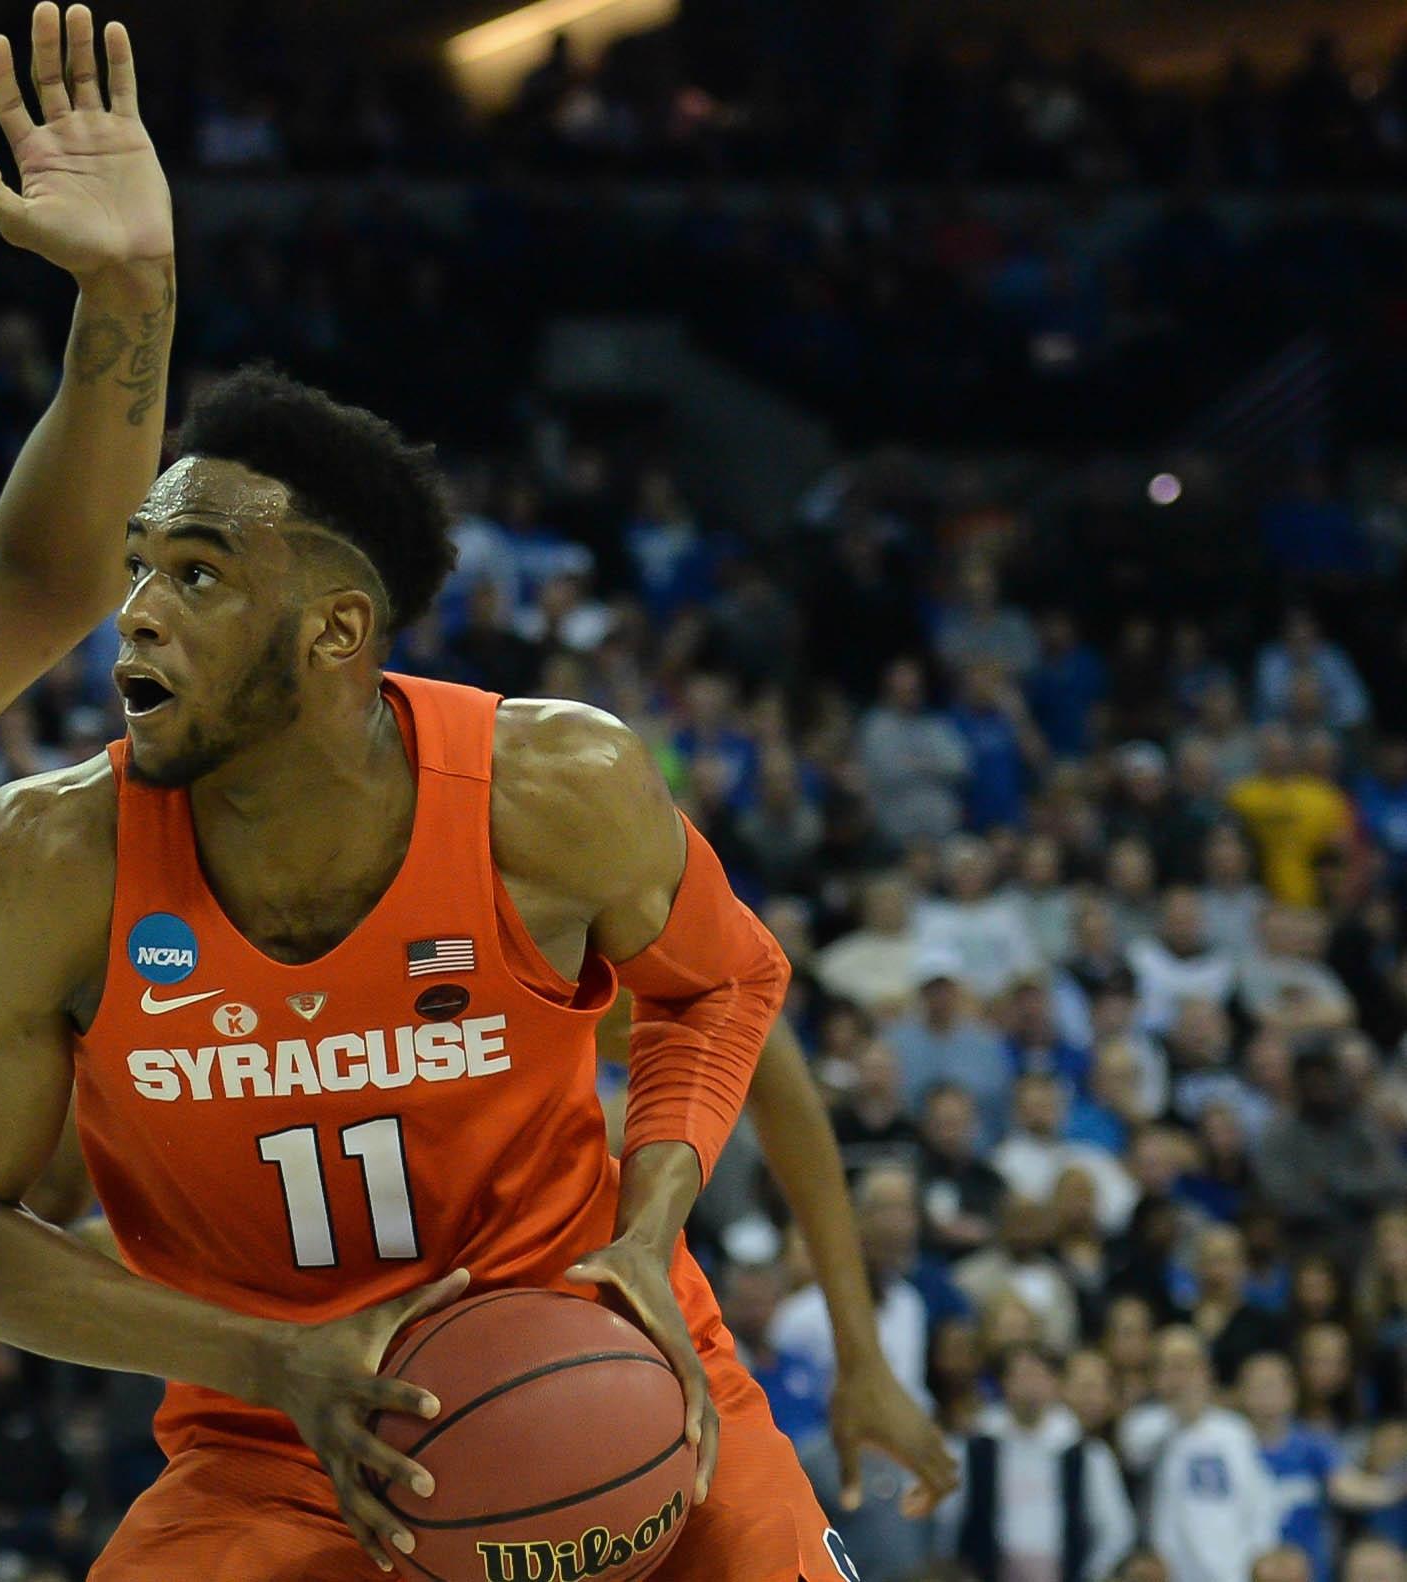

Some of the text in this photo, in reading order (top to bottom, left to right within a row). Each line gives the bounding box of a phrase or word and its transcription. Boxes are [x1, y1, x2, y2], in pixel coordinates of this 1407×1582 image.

[137, 946, 193, 967] NCAA
[126, 1013, 511, 1101] SYRACUSE
[255, 1112, 422, 1269] 11
[476, 1488, 684, 1582] Wilson
